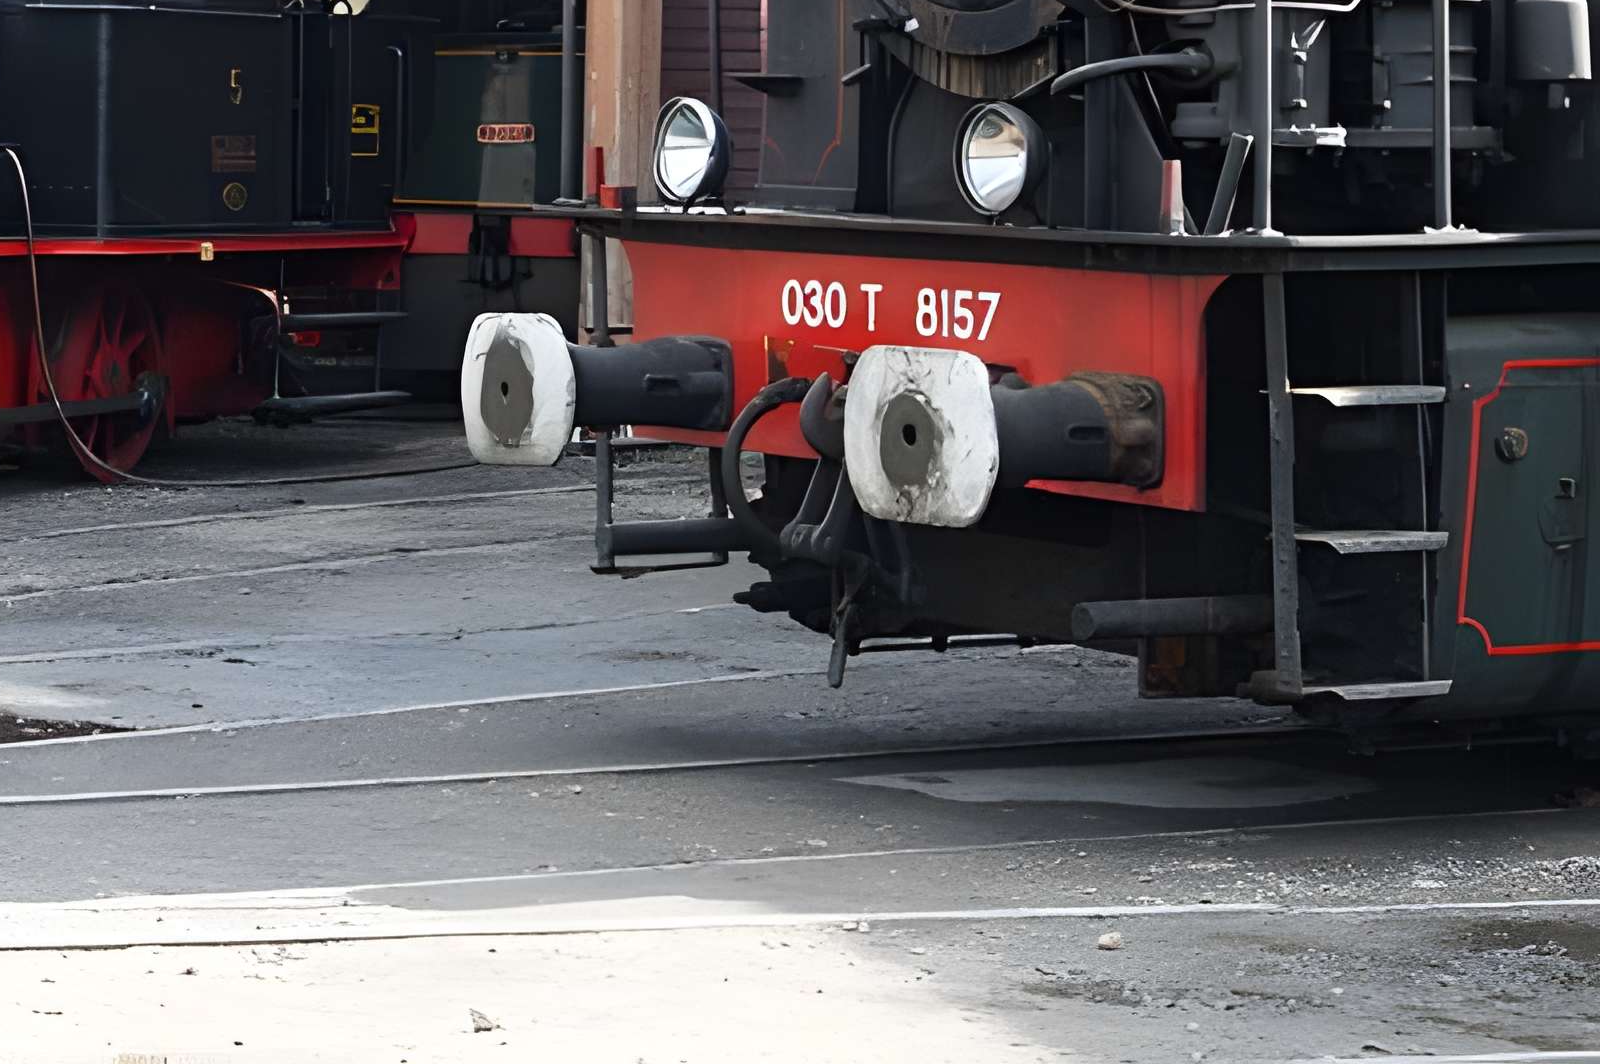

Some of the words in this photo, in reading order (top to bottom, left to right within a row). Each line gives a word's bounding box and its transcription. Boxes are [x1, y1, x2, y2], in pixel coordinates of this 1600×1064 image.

[781, 279, 847, 329] 030
[859, 283, 883, 332] T
[915, 287, 1002, 341] 8157
